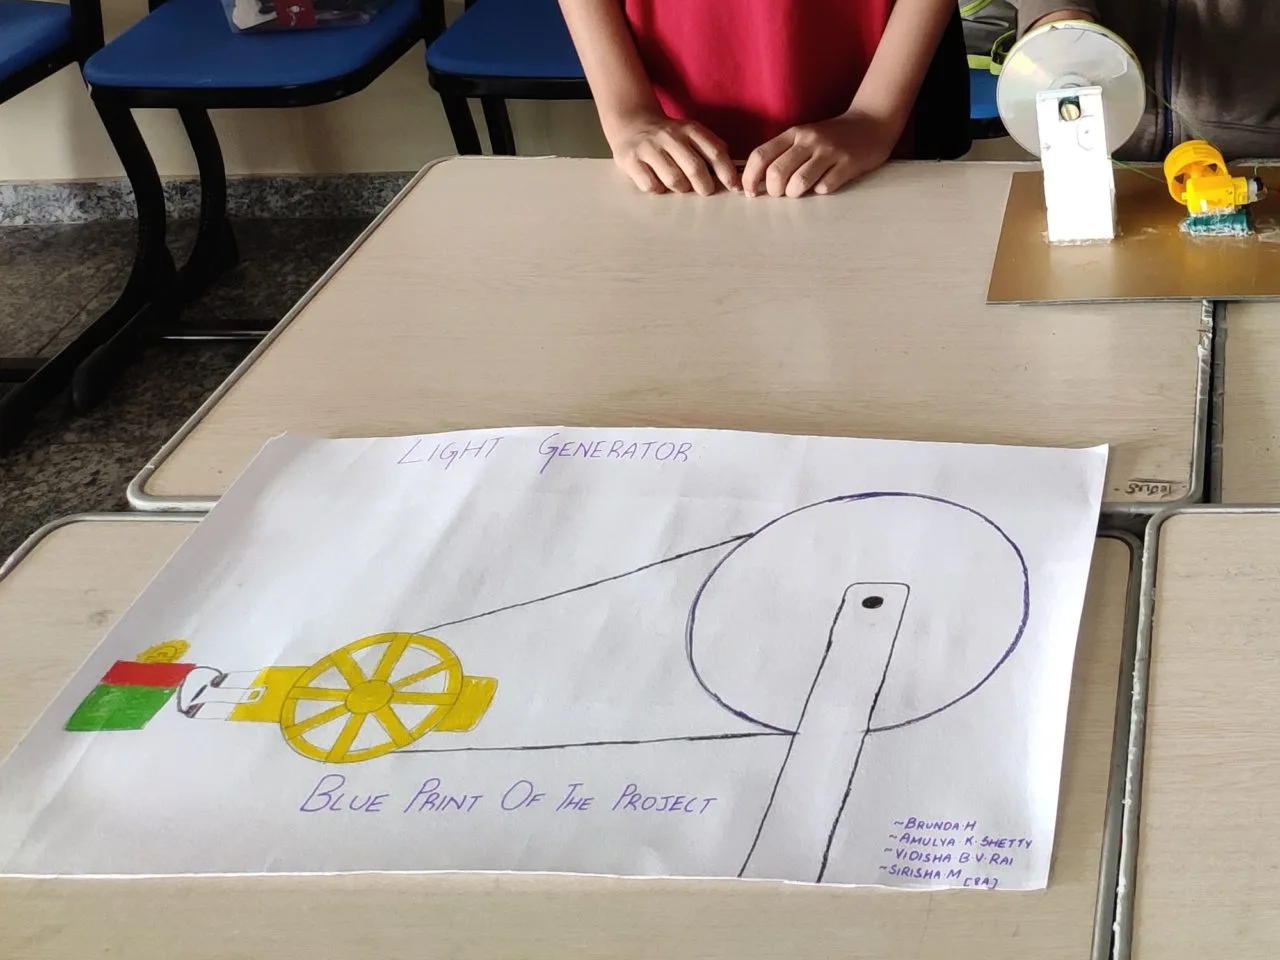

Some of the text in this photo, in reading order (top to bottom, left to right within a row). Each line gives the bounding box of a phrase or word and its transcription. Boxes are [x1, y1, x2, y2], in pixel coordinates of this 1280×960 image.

[398, 433, 693, 474] LIGHT GENERATOR
[300, 774, 718, 814] BLUE PRINT OF THE PROJECT
[980, 836, 1033, 849] SHETTY
[989, 853, 1014, 866] RAI
